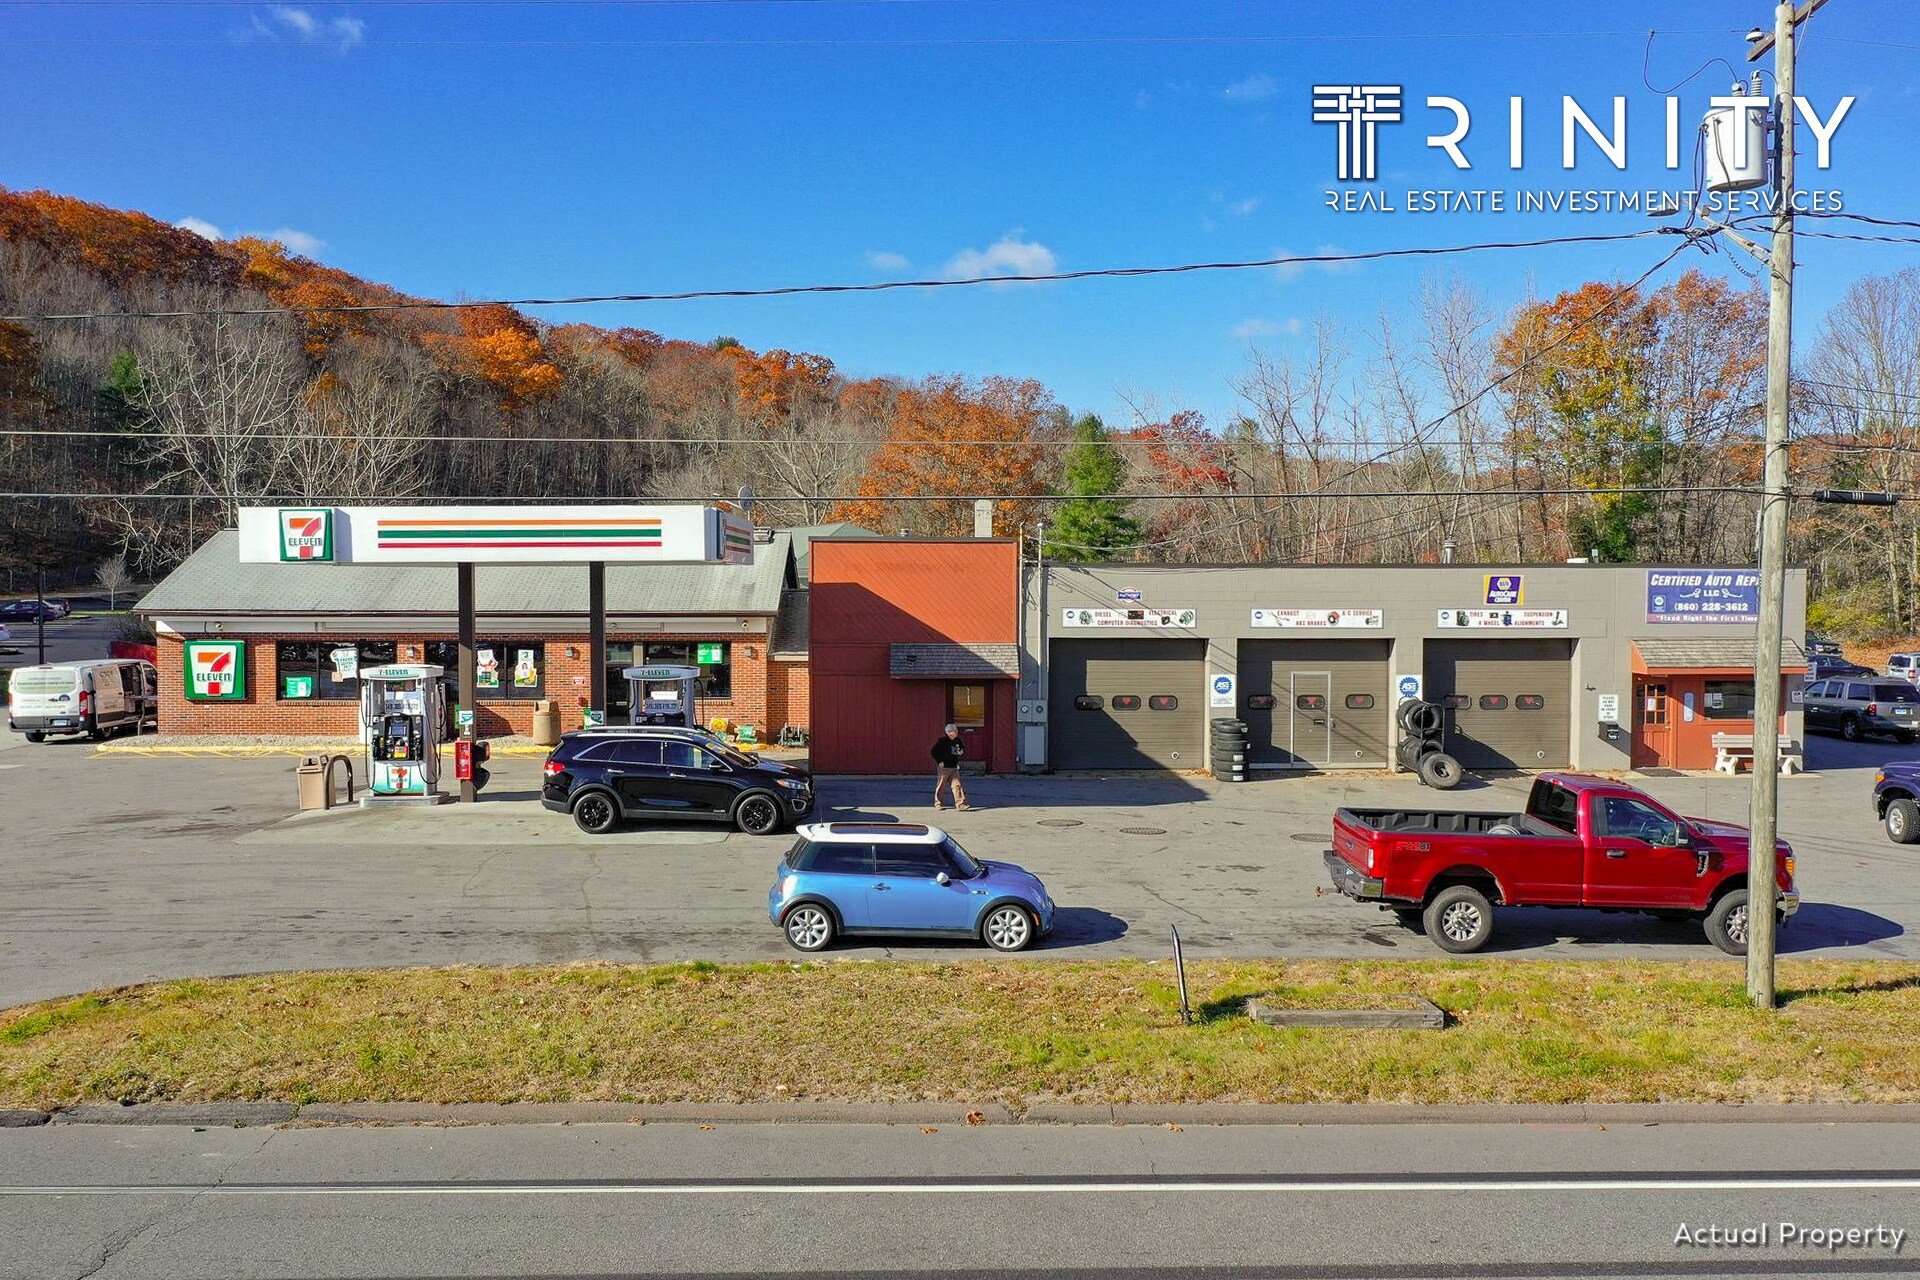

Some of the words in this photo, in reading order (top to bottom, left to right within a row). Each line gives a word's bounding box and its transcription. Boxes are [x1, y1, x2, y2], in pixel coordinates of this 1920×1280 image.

[289, 517, 322, 558] 7
[1651, 574, 1702, 586] CERTIFIED
[1705, 575, 1732, 586] AUTO
[1703, 589, 1720, 598] LLC
[1674, 602, 1699, 612] (860)
[1701, 602, 1749, 612] 228-3612
[197, 652, 232, 695] 7
